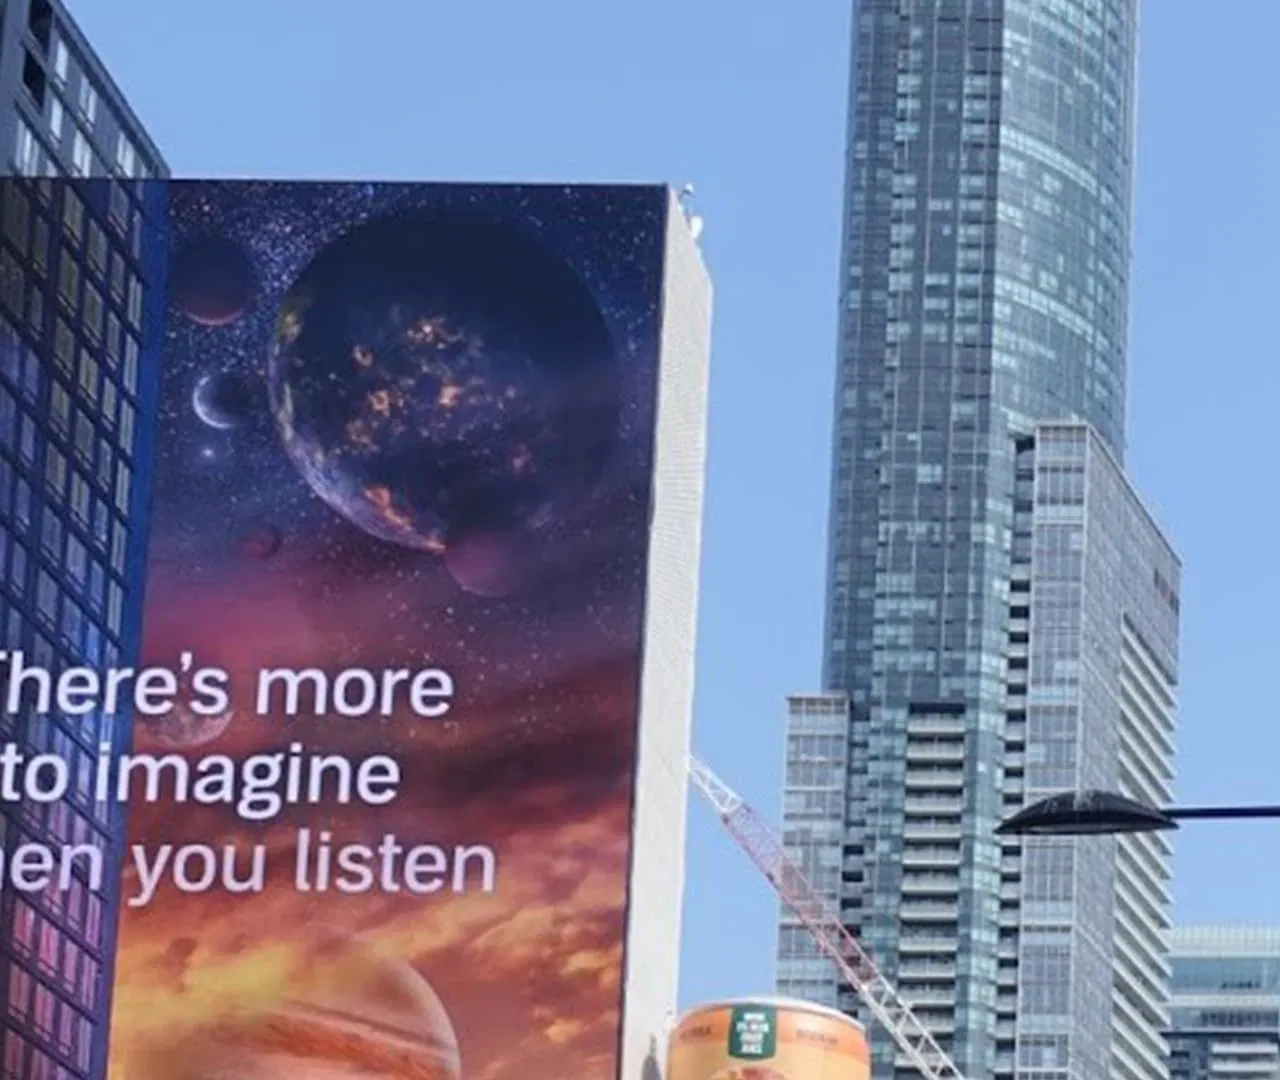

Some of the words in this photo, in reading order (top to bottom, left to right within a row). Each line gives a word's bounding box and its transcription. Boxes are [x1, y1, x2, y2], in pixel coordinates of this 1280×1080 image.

[0, 652, 229, 716] here's
[256, 666, 453, 717] more
[0, 742, 68, 802] to
[95, 742, 401, 820] imagine
[0, 842, 102, 892] en
[127, 843, 265, 907] you
[295, 828, 497, 893] listen
